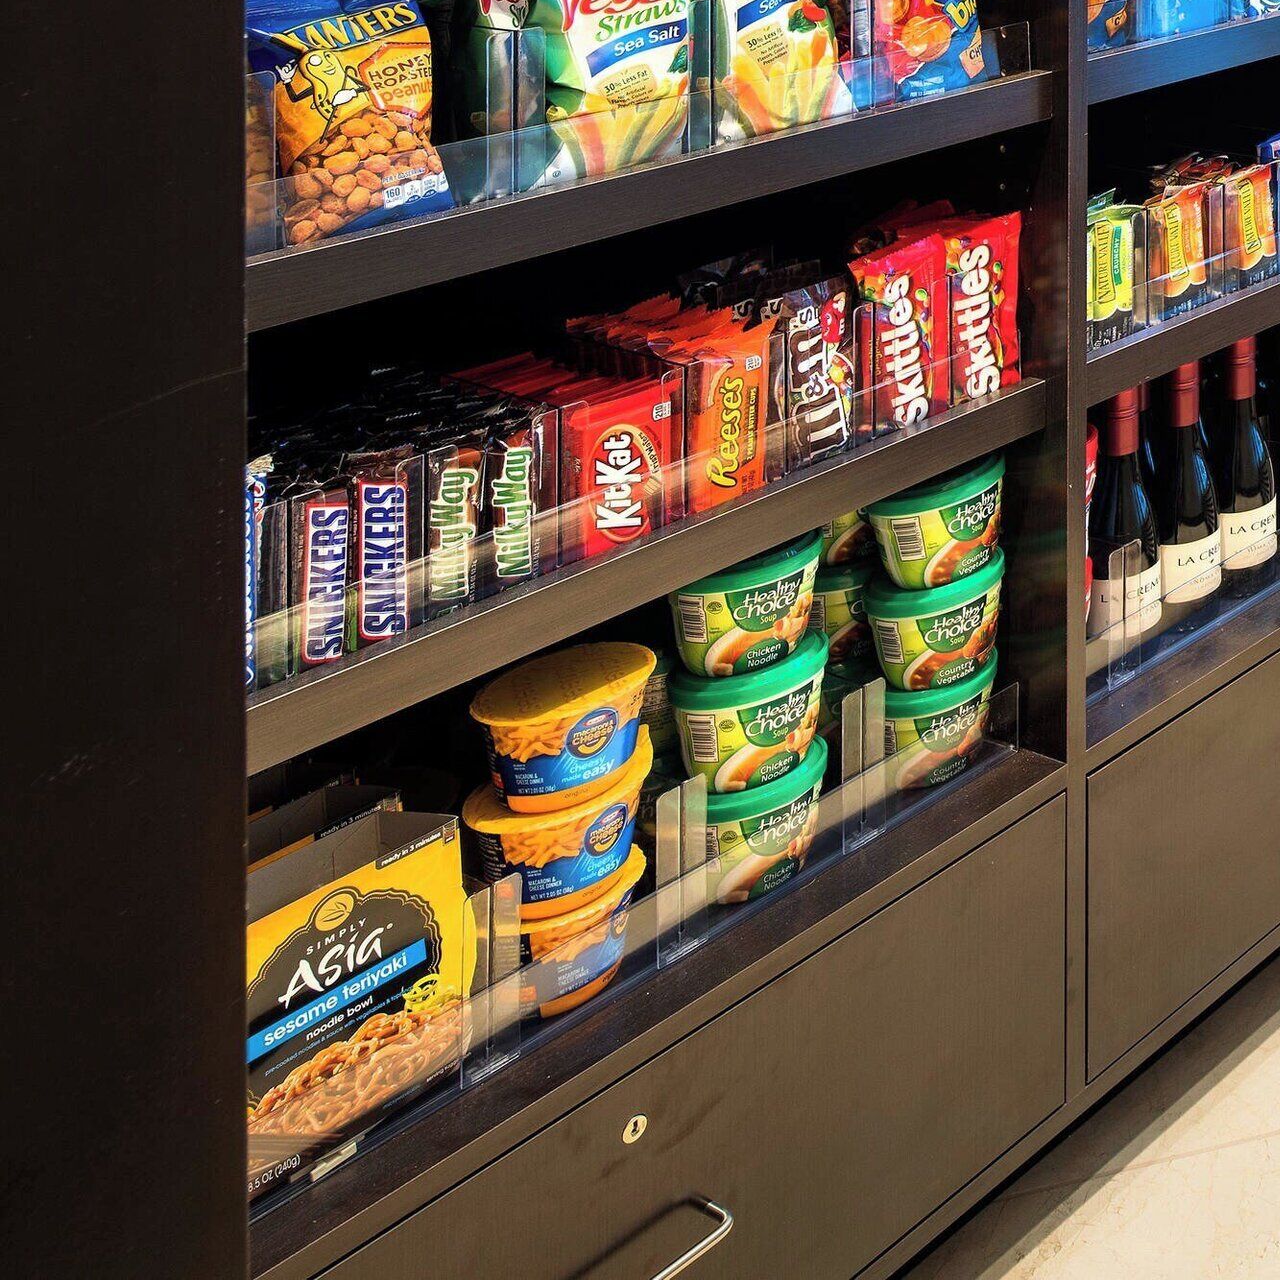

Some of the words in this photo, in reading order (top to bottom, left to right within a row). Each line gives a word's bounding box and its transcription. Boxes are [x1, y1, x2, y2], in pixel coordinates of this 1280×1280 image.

[613, 38, 645, 57] Sea
[648, 26, 681, 44] Salt
[369, 53, 432, 82] HONEY
[1113, 236, 1121, 275] CRUNCHY
[1097, 253, 1112, 304] NATURE
[953, 244, 1000, 399] Skittles
[885, 274, 928, 428] Skittles
[706, 376, 744, 488] Reese's
[491, 448, 534, 507] Way
[430, 468, 479, 526] Way
[957, 489, 1000, 521] Healthy
[947, 502, 995, 534] Choice
[1230, 524, 1247, 536] LA
[494, 504, 532, 577] Milky
[364, 485, 405, 635] SNICKERS
[958, 555, 992, 577] Vegetable
[961, 548, 991, 567] Country
[1178, 555, 1195, 568] LA
[311, 508, 348, 658] SNICKERS
[745, 578, 801, 608] Healthy
[732, 593, 796, 619] Choice
[933, 602, 983, 632] Healthy
[923, 615, 981, 644] Choice
[746, 643, 782, 660] Chicken
[747, 653, 779, 668] Noodle
[936, 666, 976, 687] Vegetable
[939, 660, 975, 678] Country
[757, 691, 813, 720] Healthy
[930, 700, 982, 730] Healthy
[745, 707, 807, 735] Choice
[921, 715, 977, 744] Choice
[570, 755, 606, 774] cheesy
[582, 759, 615, 780] easy
[760, 755, 794, 776] Chicken
[761, 764, 793, 782] Noodle
[757, 795, 813, 829] Healthy
[747, 815, 808, 848] Choice
[381, 853, 400, 867] ready
[415, 831, 443, 851] minutes
[597, 855, 622, 877] easy
[306, 917, 367, 956] SIMPLY
[278, 925, 385, 1009] Asia
[263, 996, 339, 1048] sesame
[341, 951, 409, 1001] teriyaki
[305, 1012, 345, 1042] noodle
[346, 995, 374, 1019] bowl
[275, 1153, 302, 1177] (240g)
